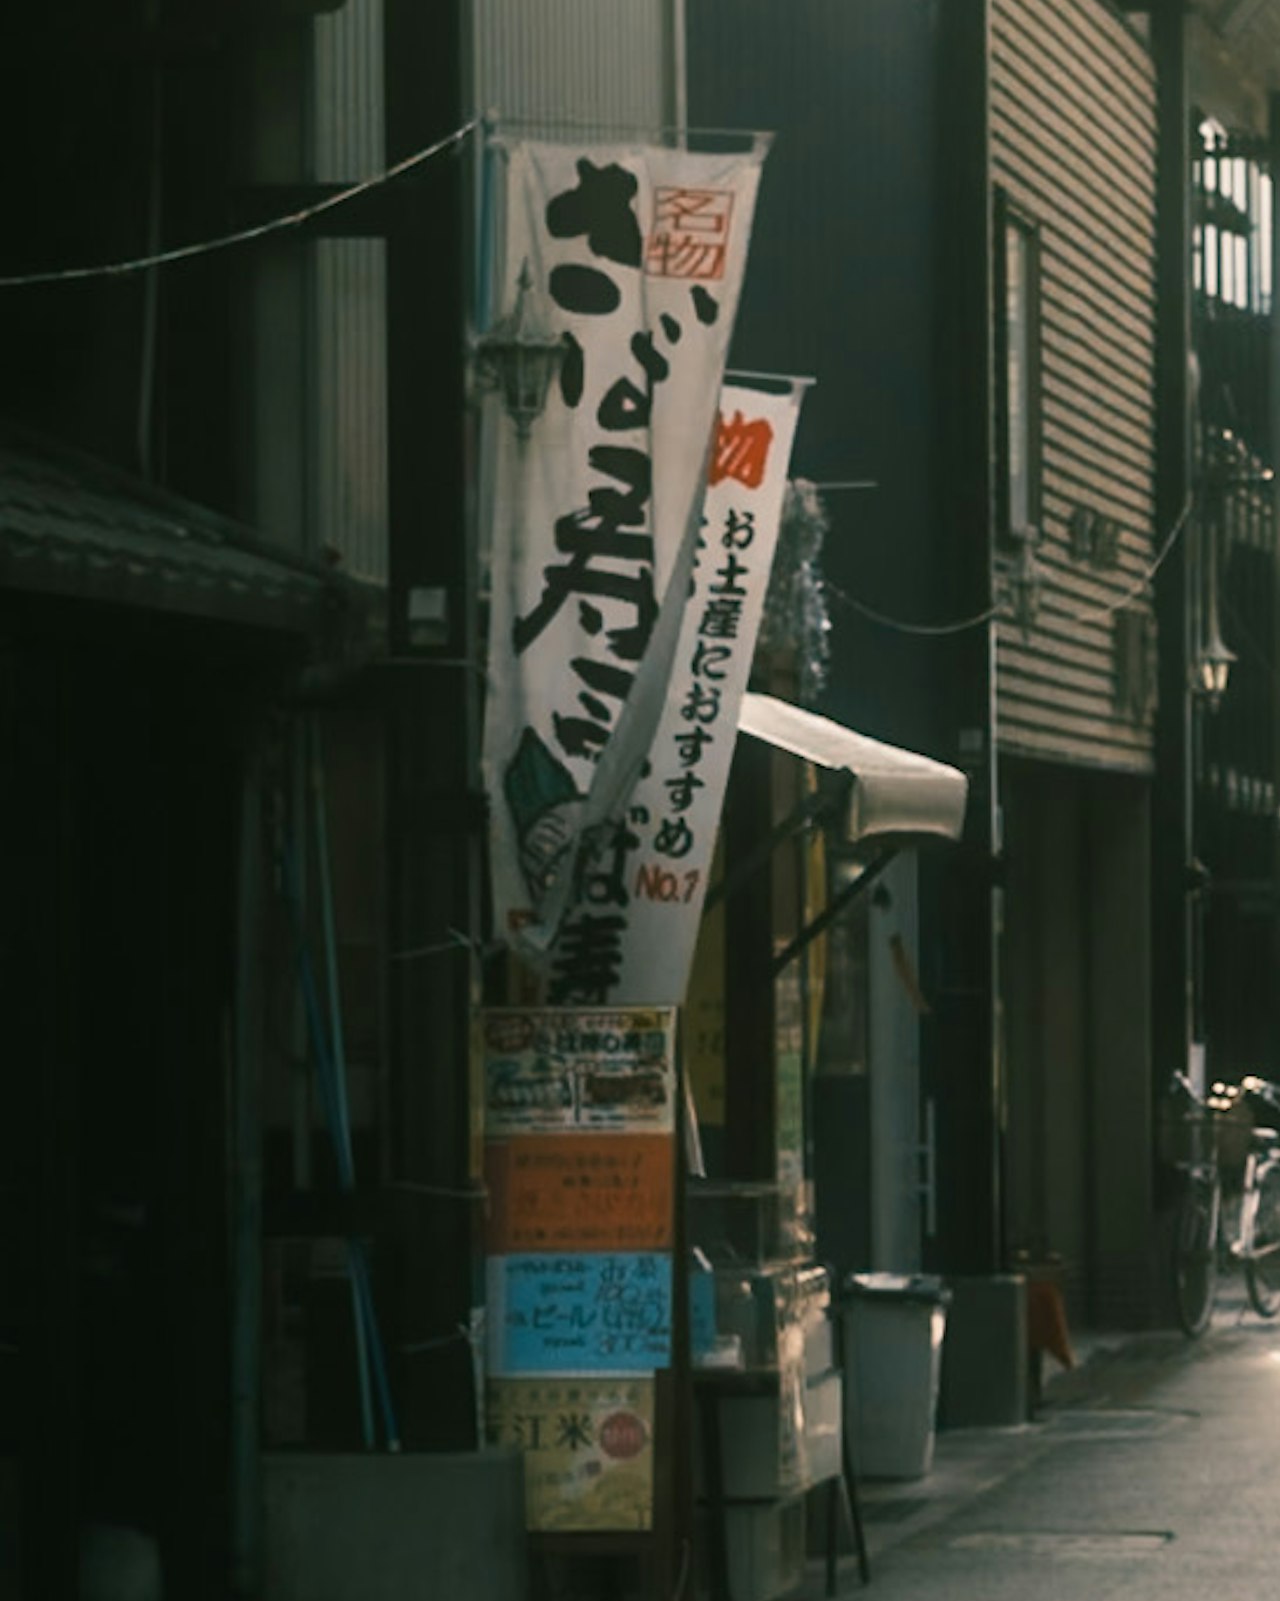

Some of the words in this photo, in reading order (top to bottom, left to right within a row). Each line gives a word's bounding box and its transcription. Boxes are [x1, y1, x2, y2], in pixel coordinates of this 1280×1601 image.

[648, 189, 726, 280] 名物
[653, 507, 756, 859] お土産におすすめ
